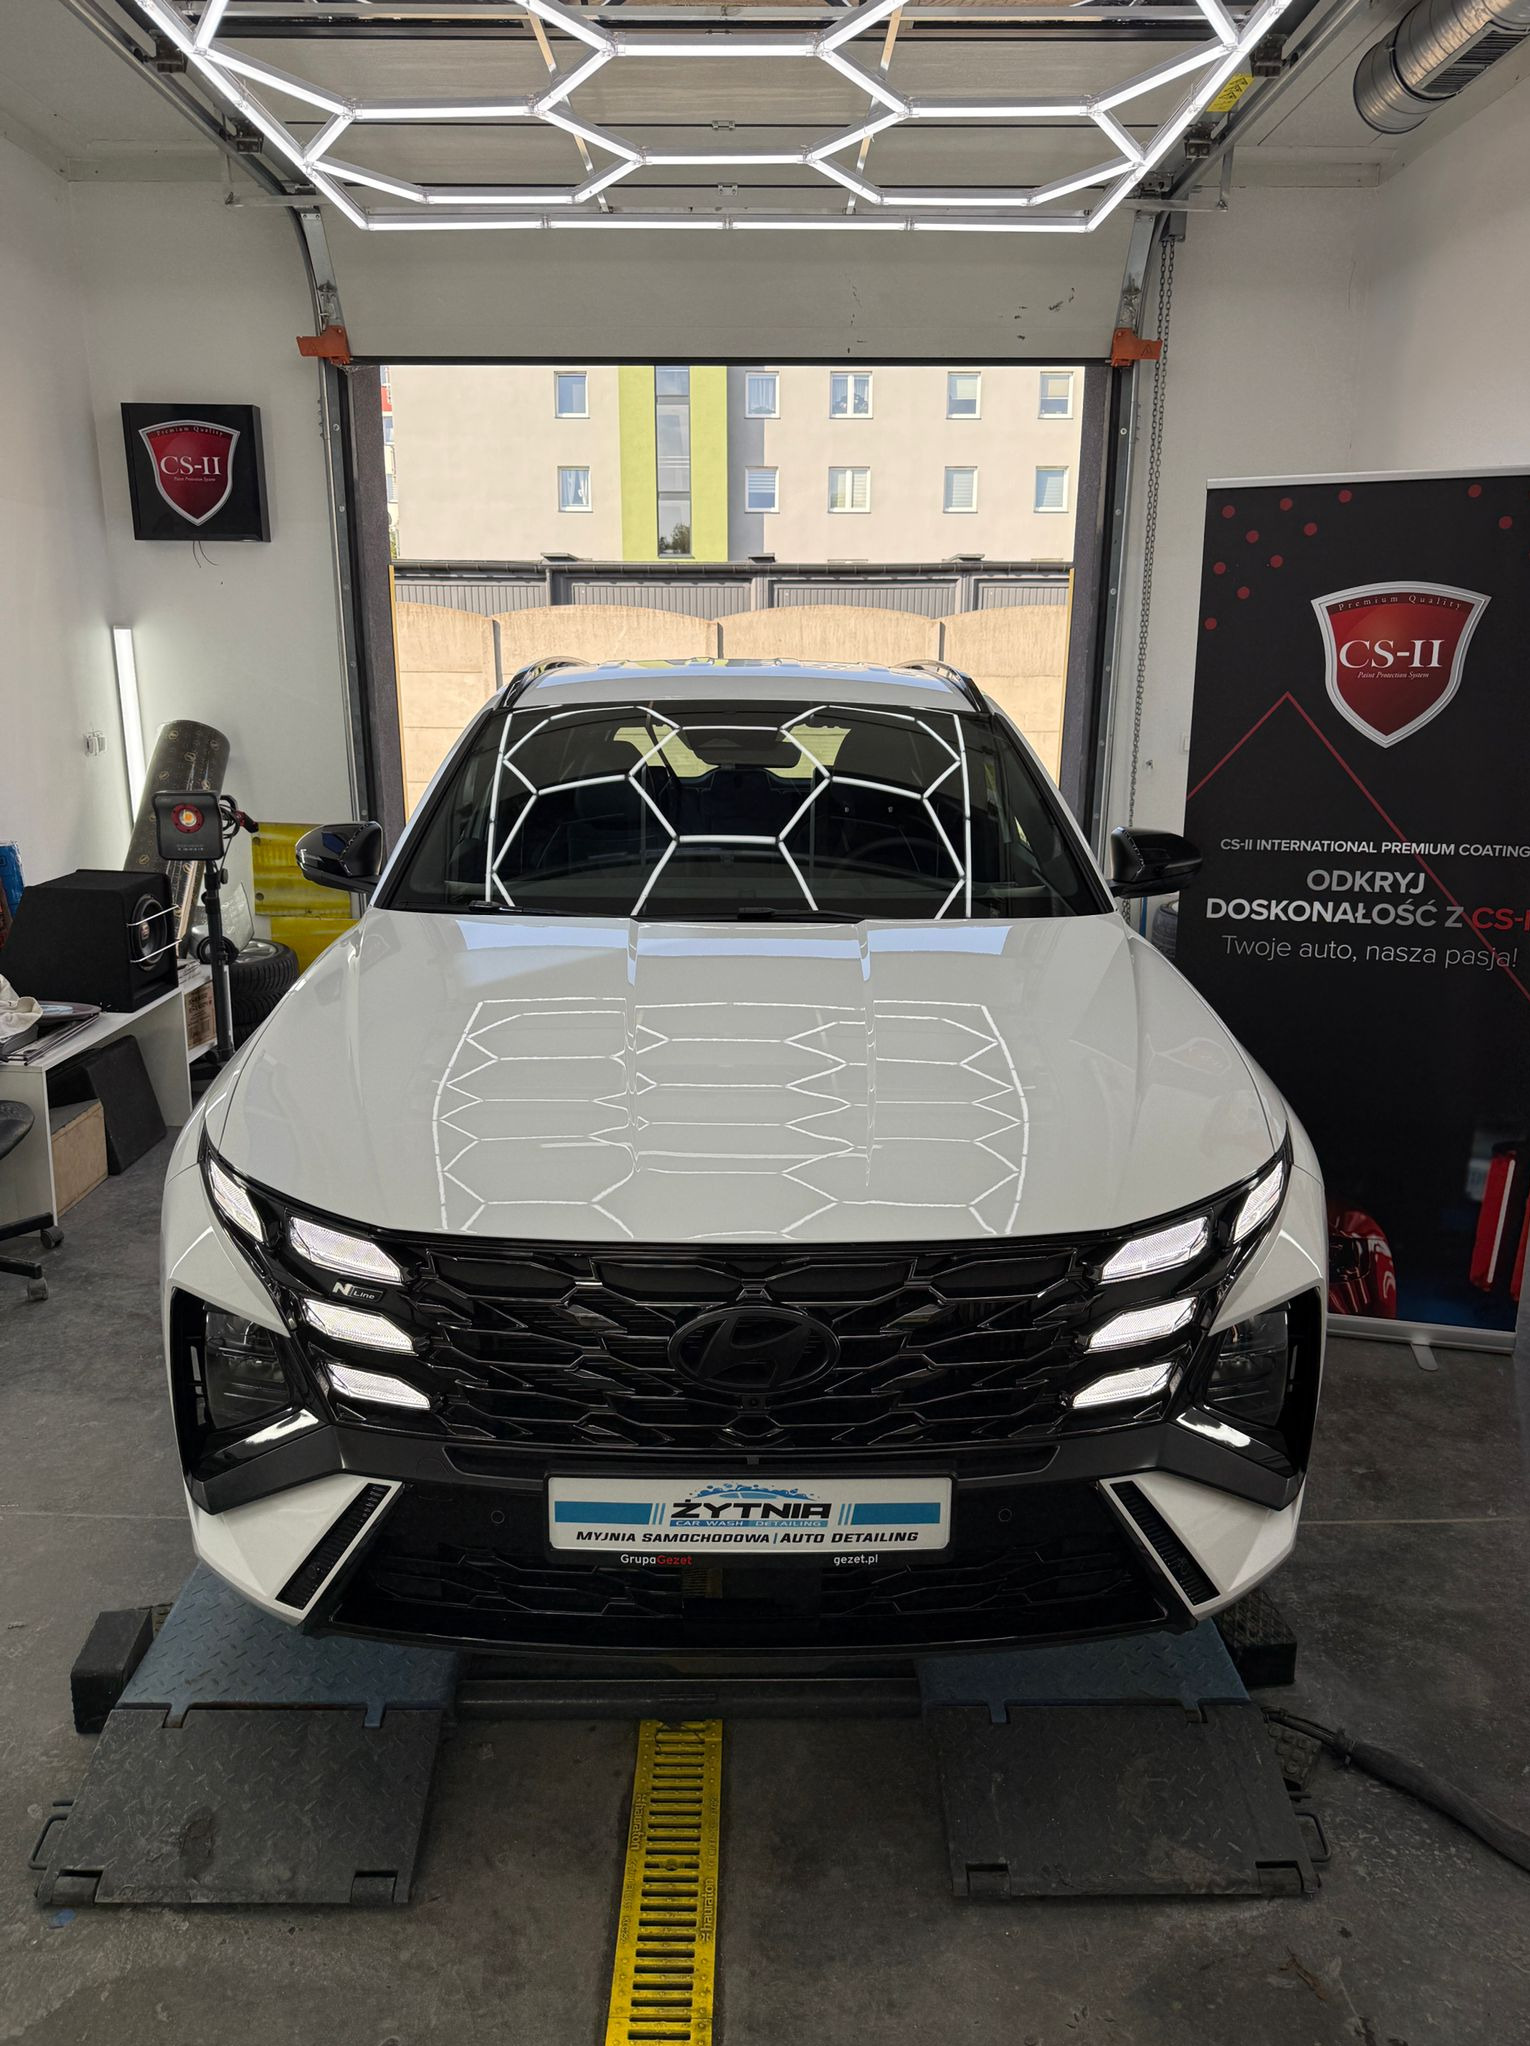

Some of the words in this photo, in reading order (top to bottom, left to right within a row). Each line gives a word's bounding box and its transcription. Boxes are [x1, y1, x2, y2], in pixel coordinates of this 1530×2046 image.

[160, 455, 221, 475] CS-II
[1338, 595, 1399, 611] Premium
[1408, 594, 1461, 610] Quality
[1339, 639, 1445, 669] CS-II
[1357, 671, 1375, 679] Paint
[1376, 671, 1407, 679] Protection
[1408, 671, 1430, 680] System
[1220, 838, 1253, 851] CS-II
[1256, 839, 1377, 853] INTERNATIONAL
[1381, 841, 1455, 856] PREMIUM
[1306, 869, 1426, 895] ODKRYJ
[1206, 897, 1438, 927] DOSKONAŁOŚĆ
[1444, 906, 1464, 928] Z
[1221, 934, 1291, 961] Twoje
[1299, 940, 1357, 963] auto,
[1366, 945, 1437, 964] nasza
[1445, 947, 1518, 971] pasja!
[353, 1291, 375, 1300] Line
[671, 1499, 832, 1519] ŻYTNIA
[576, 1531, 636, 1542] MYJNIA
[642, 1533, 770, 1543] SAMOCHODOWA
[779, 1533, 825, 1543] AUTO
[831, 1532, 919, 1543] DETAILING
[620, 1554, 693, 1566] GrupaGezet
[833, 1554, 878, 1566] gezet.pl
[700, 1878, 714, 1932] hauraton
